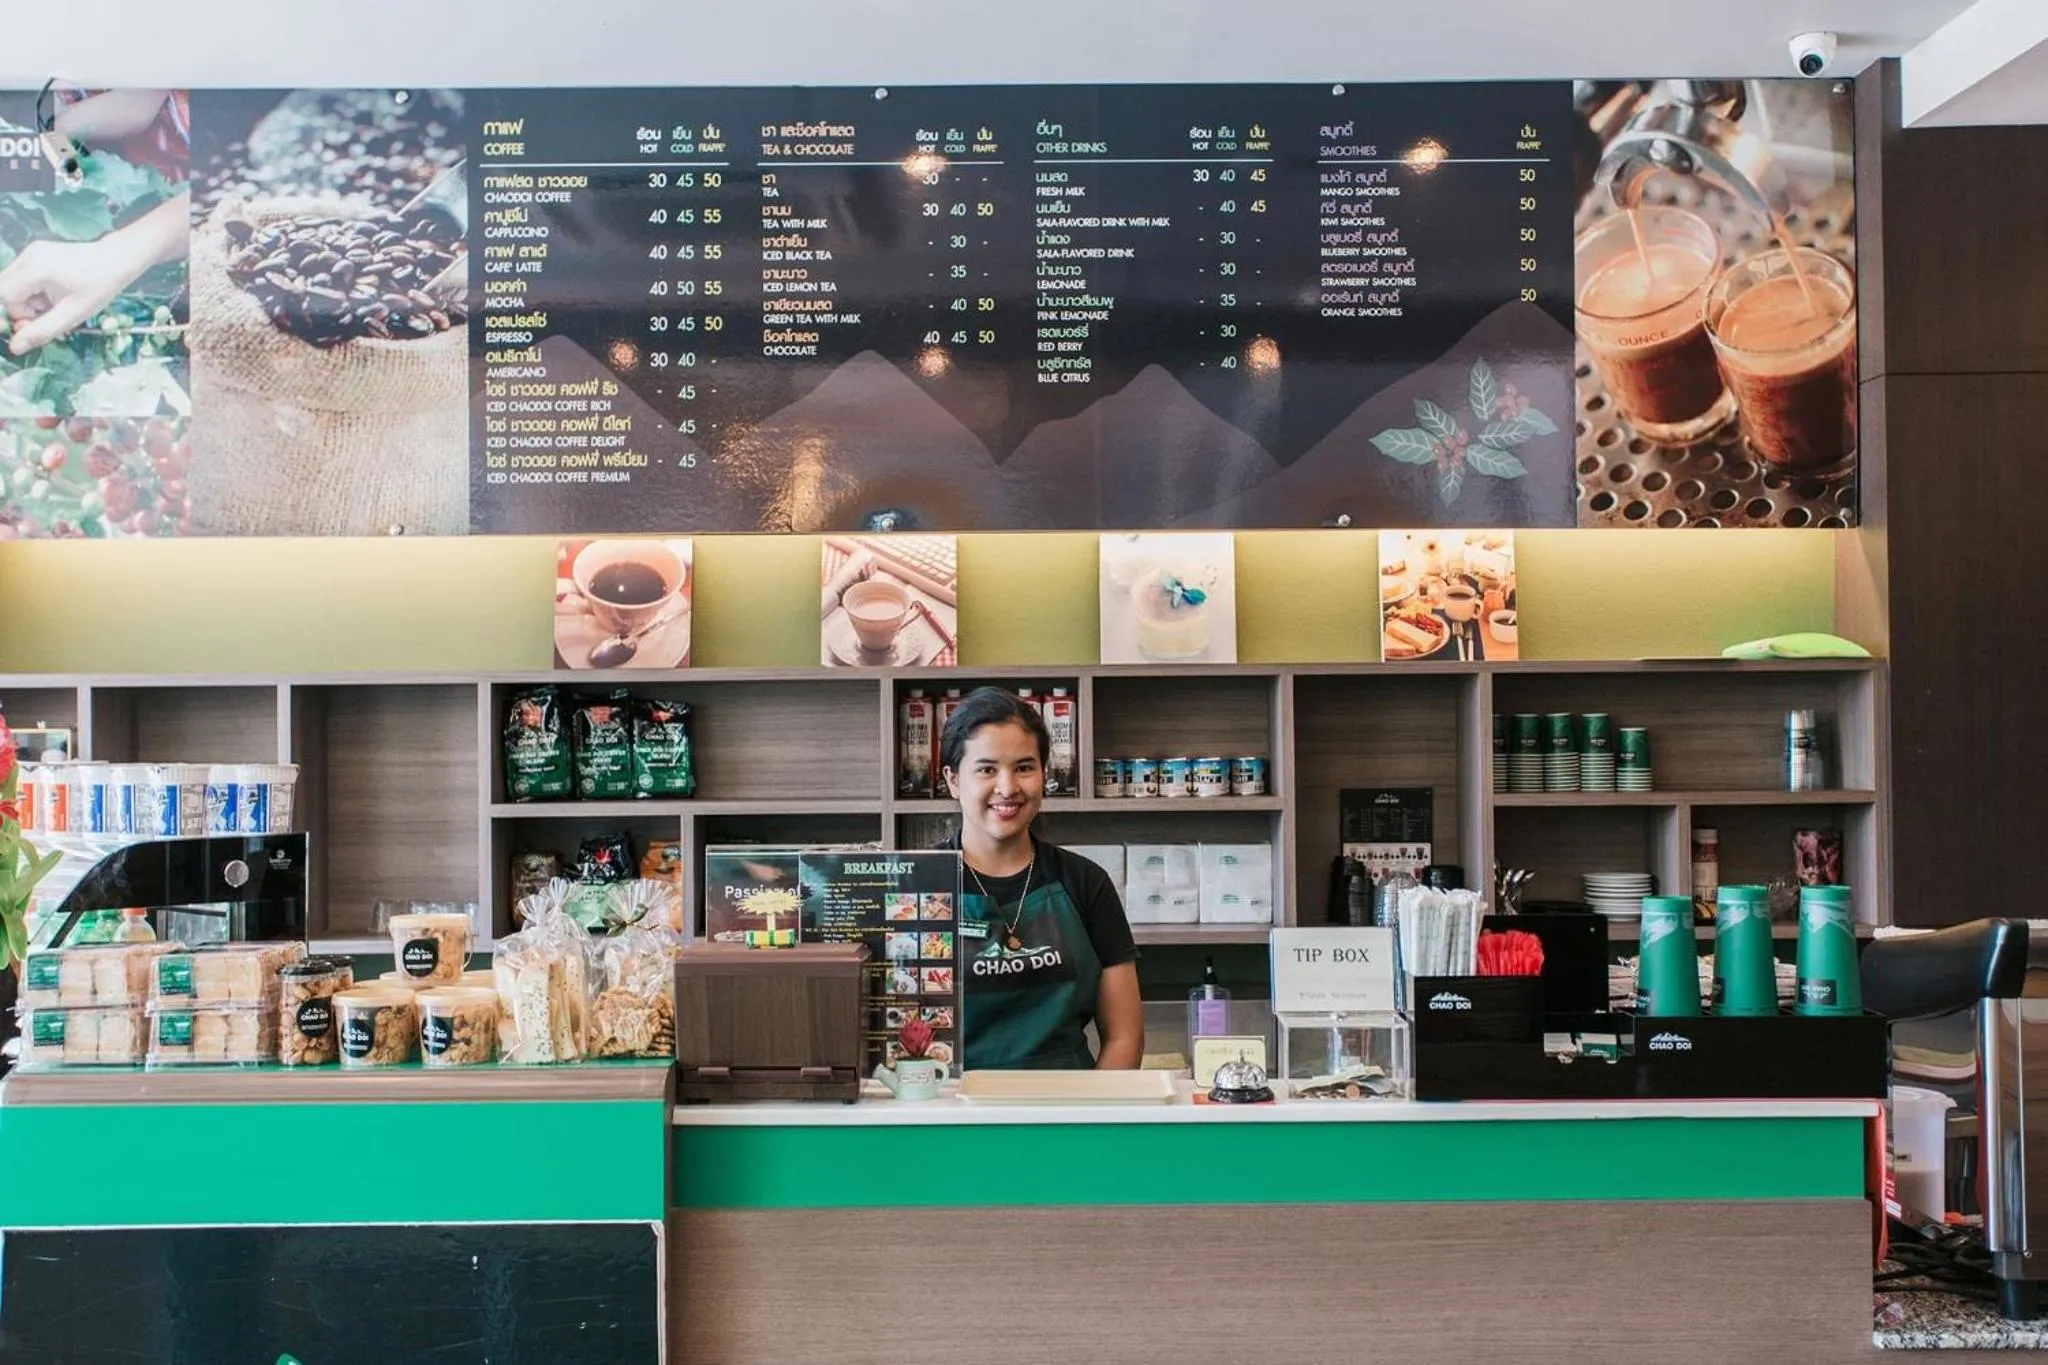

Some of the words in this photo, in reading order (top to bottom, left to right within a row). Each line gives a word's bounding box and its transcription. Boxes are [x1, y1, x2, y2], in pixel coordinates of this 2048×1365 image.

[484, 119, 523, 135] กาแฟ
[484, 143, 524, 155] COFFEE
[640, 144, 657, 153] HOT
[671, 144, 694, 153] COLD
[762, 144, 780, 155] TEA
[783, 144, 792, 155] &
[794, 144, 853, 155] CHOCOLATE
[944, 145, 966, 153] COLD
[1036, 142, 1068, 153] OTHER
[1072, 143, 1107, 153] DRINKS
[1193, 142, 1208, 150] HOT
[1216, 142, 1237, 150] COLD
[1321, 146, 1376, 156] SMOOTHIES
[649, 173, 666, 187] 30
[676, 173, 693, 187] 45
[704, 173, 721, 187] 50
[1194, 169, 1209, 181] 30
[1220, 169, 1235, 181] 40
[1251, 169, 1265, 181] 45
[1520, 169, 1535, 181] 50
[535, 192, 571, 202] COFFEE
[763, 187, 779, 197] TEA
[1036, 187, 1062, 196] FRESH
[1065, 187, 1085, 195] MILK
[1321, 188, 1353, 196] MANGO
[1356, 187, 1400, 196] SMOOTHIES
[923, 203, 938, 216] 30
[951, 204, 966, 216] 40
[978, 203, 993, 216] 50
[1220, 200, 1235, 212] 40
[1251, 200, 1266, 212] 45
[1520, 198, 1535, 210] 50
[649, 209, 667, 223] 40
[677, 210, 694, 223] 45
[704, 209, 721, 223] 55
[1341, 217, 1385, 226] SMOOTHIES
[762, 219, 779, 228] TEA
[782, 219, 804, 228] WITH
[807, 219, 827, 228] MILK
[1102, 218, 1126, 226] DRINK
[485, 227, 548, 238] CAPPUCCINO
[1220, 232, 1235, 244] 30
[1521, 229, 1536, 241] 50
[951, 235, 966, 248] 30
[649, 245, 667, 259] 40
[677, 245, 694, 259] 45
[704, 245, 721, 259] 55
[763, 251, 783, 260] ICED
[786, 251, 813, 260] BLACK
[816, 251, 832, 260] TEA
[1037, 249, 1105, 258] SALA-FLAVORED
[1108, 249, 1134, 258] DRINK
[1321, 248, 1360, 256] BLUEBERRY
[1363, 247, 1407, 256] SMOOTHIES
[516, 262, 542, 272] LATTE
[1220, 263, 1236, 275] 30
[1521, 259, 1536, 271] 50
[951, 265, 966, 277] 35
[763, 282, 783, 292] ICED
[786, 282, 818, 292] LEMON
[820, 282, 836, 291] TEA
[1037, 280, 1086, 289] LEMONADE
[1322, 278, 1370, 286] STRAWBERRY
[1373, 277, 1416, 286] SMOOTHIES
[649, 281, 667, 295] 40
[677, 281, 694, 295] 50
[705, 281, 722, 295] 55
[1221, 294, 1236, 306] 35
[1521, 289, 1536, 301] 50
[485, 297, 524, 308] MOCHA
[951, 298, 967, 310] 40
[978, 298, 994, 310] 50
[1038, 311, 1058, 320] PINK
[1061, 311, 1108, 320] LEMONADE
[1321, 308, 1355, 316] ORANGE
[1358, 308, 1402, 316] SMOOTHIES
[650, 317, 668, 331] 30
[678, 317, 695, 331] 45
[705, 316, 722, 330] 50
[763, 314, 793, 324] GREEN
[796, 314, 812, 323] TEA
[815, 314, 837, 323] WITH
[840, 314, 860, 323] MILK
[1221, 325, 1236, 337] 30
[486, 332, 532, 343] ESPRESSO
[924, 331, 940, 343] 40
[952, 331, 967, 343] 45
[979, 331, 994, 343] 50
[1618, 331, 1668, 346] OUNCE
[764, 346, 816, 355] CHOCOLATE
[1038, 342, 1055, 351] RED
[1058, 342, 1082, 351] BERRY
[651, 353, 668, 367] 30
[678, 353, 695, 367] 40
[1221, 356, 1236, 368] 40
[486, 367, 546, 378] AMERICANO
[1038, 373, 1058, 382] BLUE
[1061, 373, 1090, 382] CITRUS
[678, 386, 695, 399] 45
[487, 401, 506, 412] ICED
[554, 400, 587, 411] COFFEE
[591, 400, 611, 411] RICH
[678, 420, 695, 433] 45
[487, 437, 507, 448] ICED
[555, 436, 588, 447] COFFEE
[591, 436, 625, 446] DELIGHT
[679, 454, 696, 467] 45
[487, 472, 507, 483] ICED
[555, 472, 588, 483] COFFEE
[591, 472, 630, 482] PREMIUM
[844, 862, 914, 875] BREAKFAST
[1294, 948, 1322, 961] TIP
[1334, 949, 1368, 962] BOX
[973, 958, 1024, 975] CHAO
[1030, 951, 1062, 970] DOI
[1456, 1001, 1472, 1009] DOI
[436, 1031, 447, 1039] DOI
[1649, 1042, 1674, 1051] CHAO
[1676, 1042, 1692, 1050] DOI
